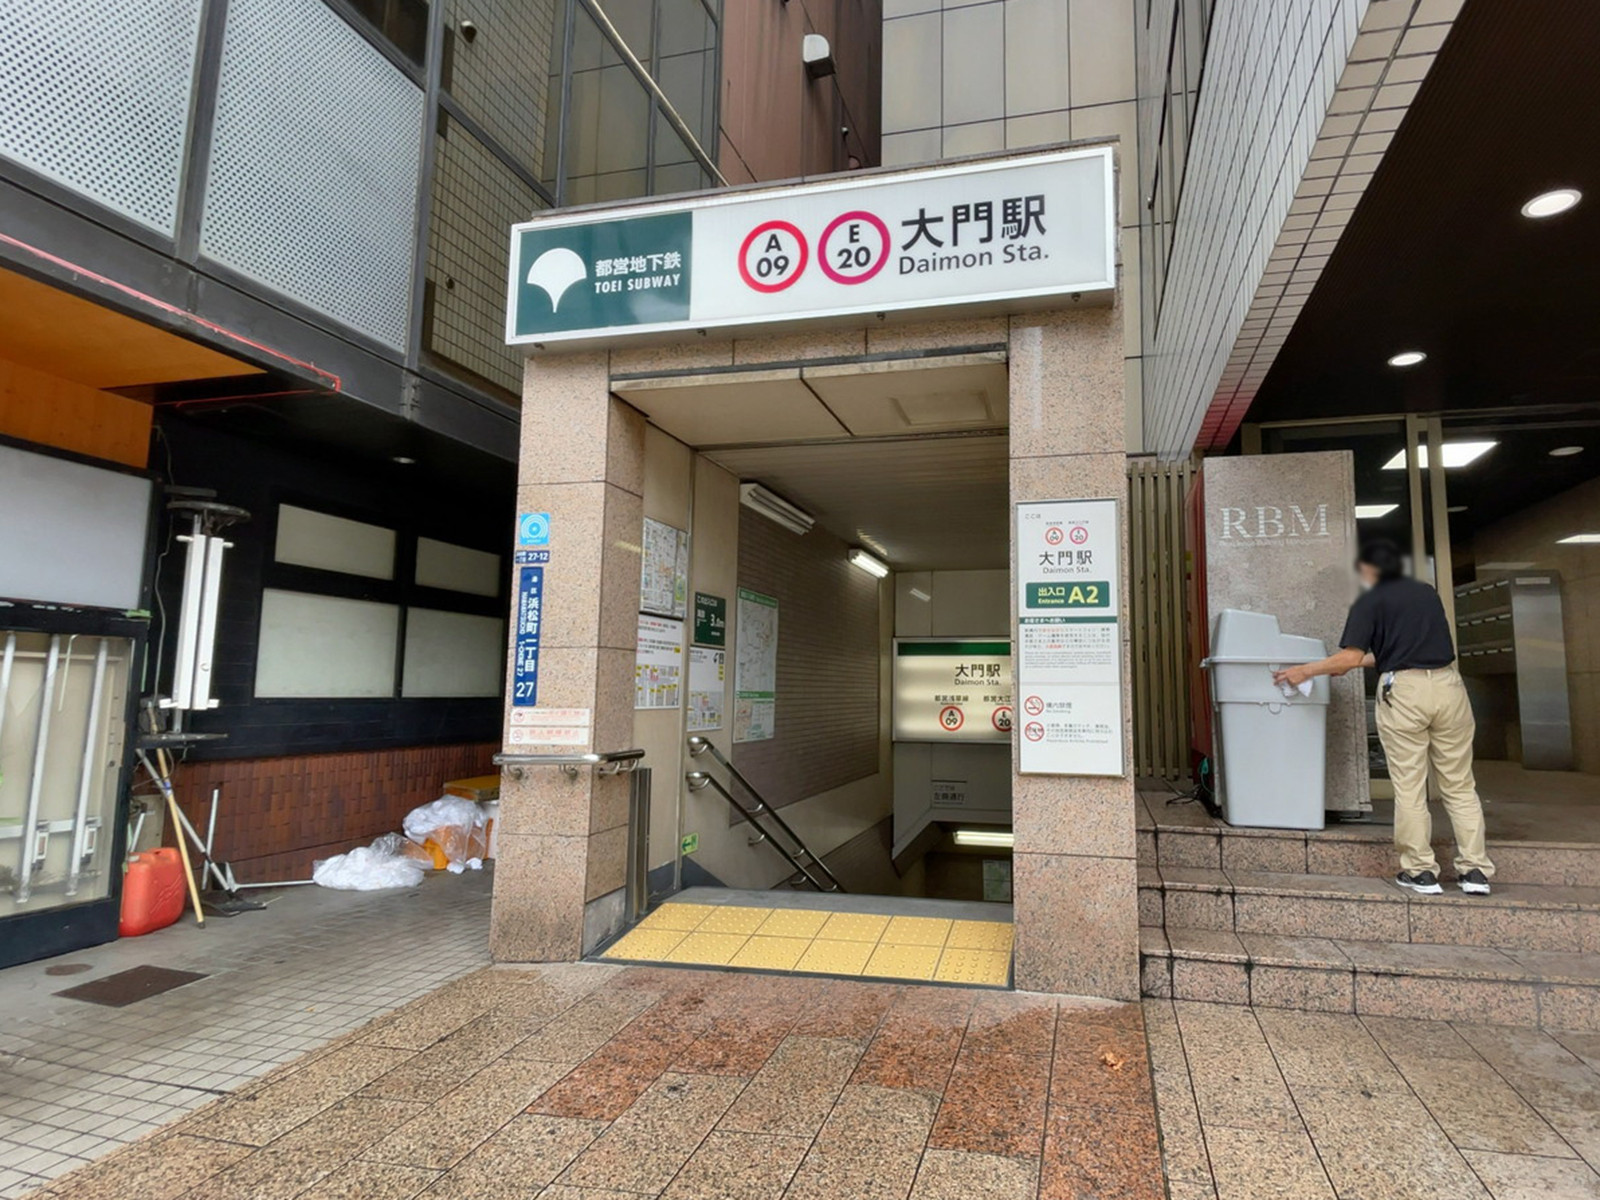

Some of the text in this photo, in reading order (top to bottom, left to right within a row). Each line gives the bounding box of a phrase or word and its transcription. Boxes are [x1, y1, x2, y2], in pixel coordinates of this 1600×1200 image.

[900, 194, 1047, 252] 大門駅
[849, 224, 860, 243] E
[765, 233, 782, 253] A
[595, 251, 681, 277] 都営地下鉄
[756, 255, 790, 278] 09
[837, 246, 871, 270] 20
[899, 243, 1049, 275] Daimon Sta.
[594, 273, 680, 294] TOEI SUBWAY
[1219, 504, 1331, 539] RBM
[528, 552, 548, 561] 27-12
[1039, 550, 1092, 566] 大門駅
[1043, 566, 1074, 574] Daimon
[1038, 587, 1065, 596] 出入口
[1068, 586, 1098, 604] A2
[955, 664, 1000, 678] 大門駅
[516, 682, 534, 697] 27
[946, 717, 958, 726] 09
[998, 718, 1011, 727] 20
